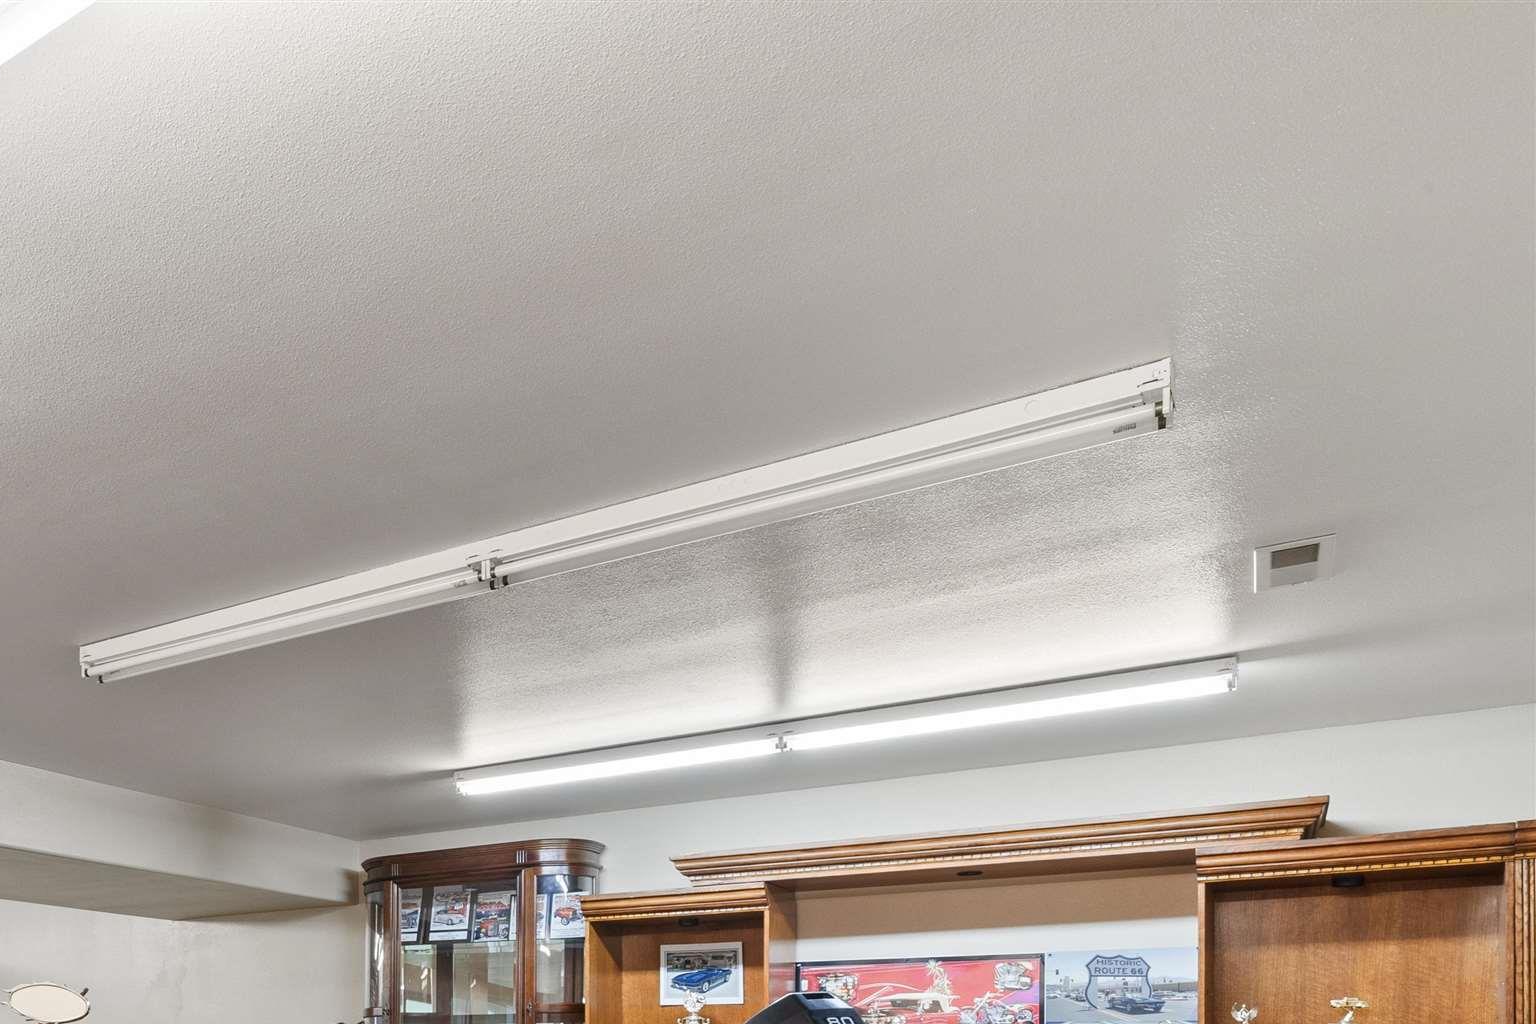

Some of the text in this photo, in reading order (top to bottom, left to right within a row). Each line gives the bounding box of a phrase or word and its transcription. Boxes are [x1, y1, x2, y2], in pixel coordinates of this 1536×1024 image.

[1096, 958, 1141, 967] HISTORIC
[1094, 967, 1144, 975] ROUTE 66
